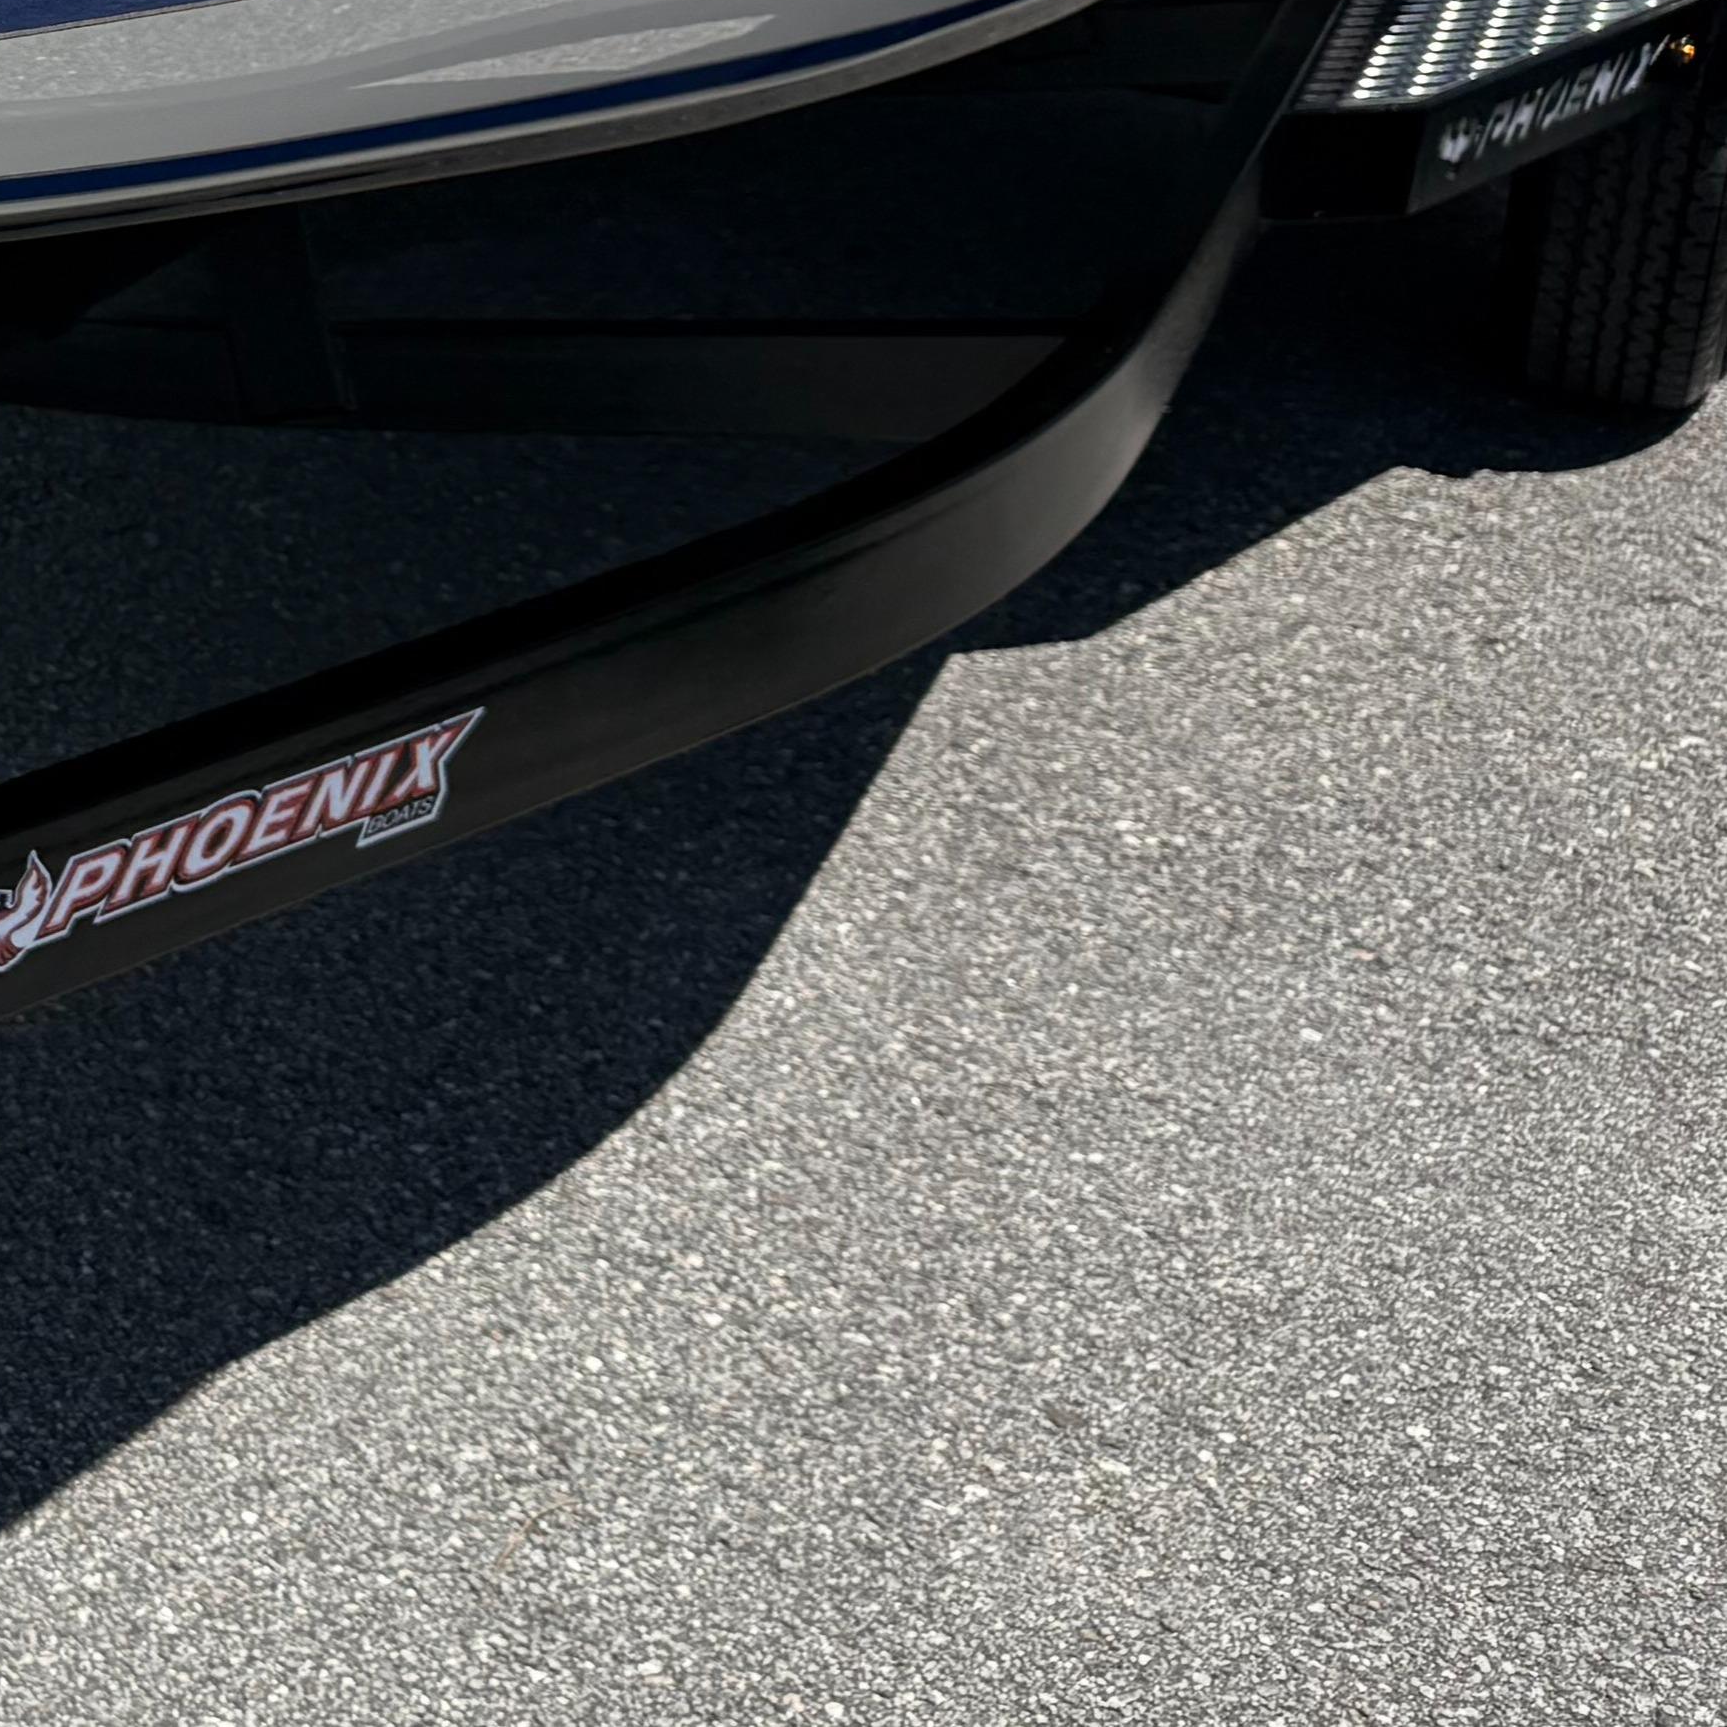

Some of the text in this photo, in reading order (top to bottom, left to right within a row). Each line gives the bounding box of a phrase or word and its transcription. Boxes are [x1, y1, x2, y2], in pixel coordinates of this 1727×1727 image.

[1474, 34, 1671, 160] PHOENIX
[34, 709, 484, 940] PHOENIX
[368, 795, 435, 835] BOATS
